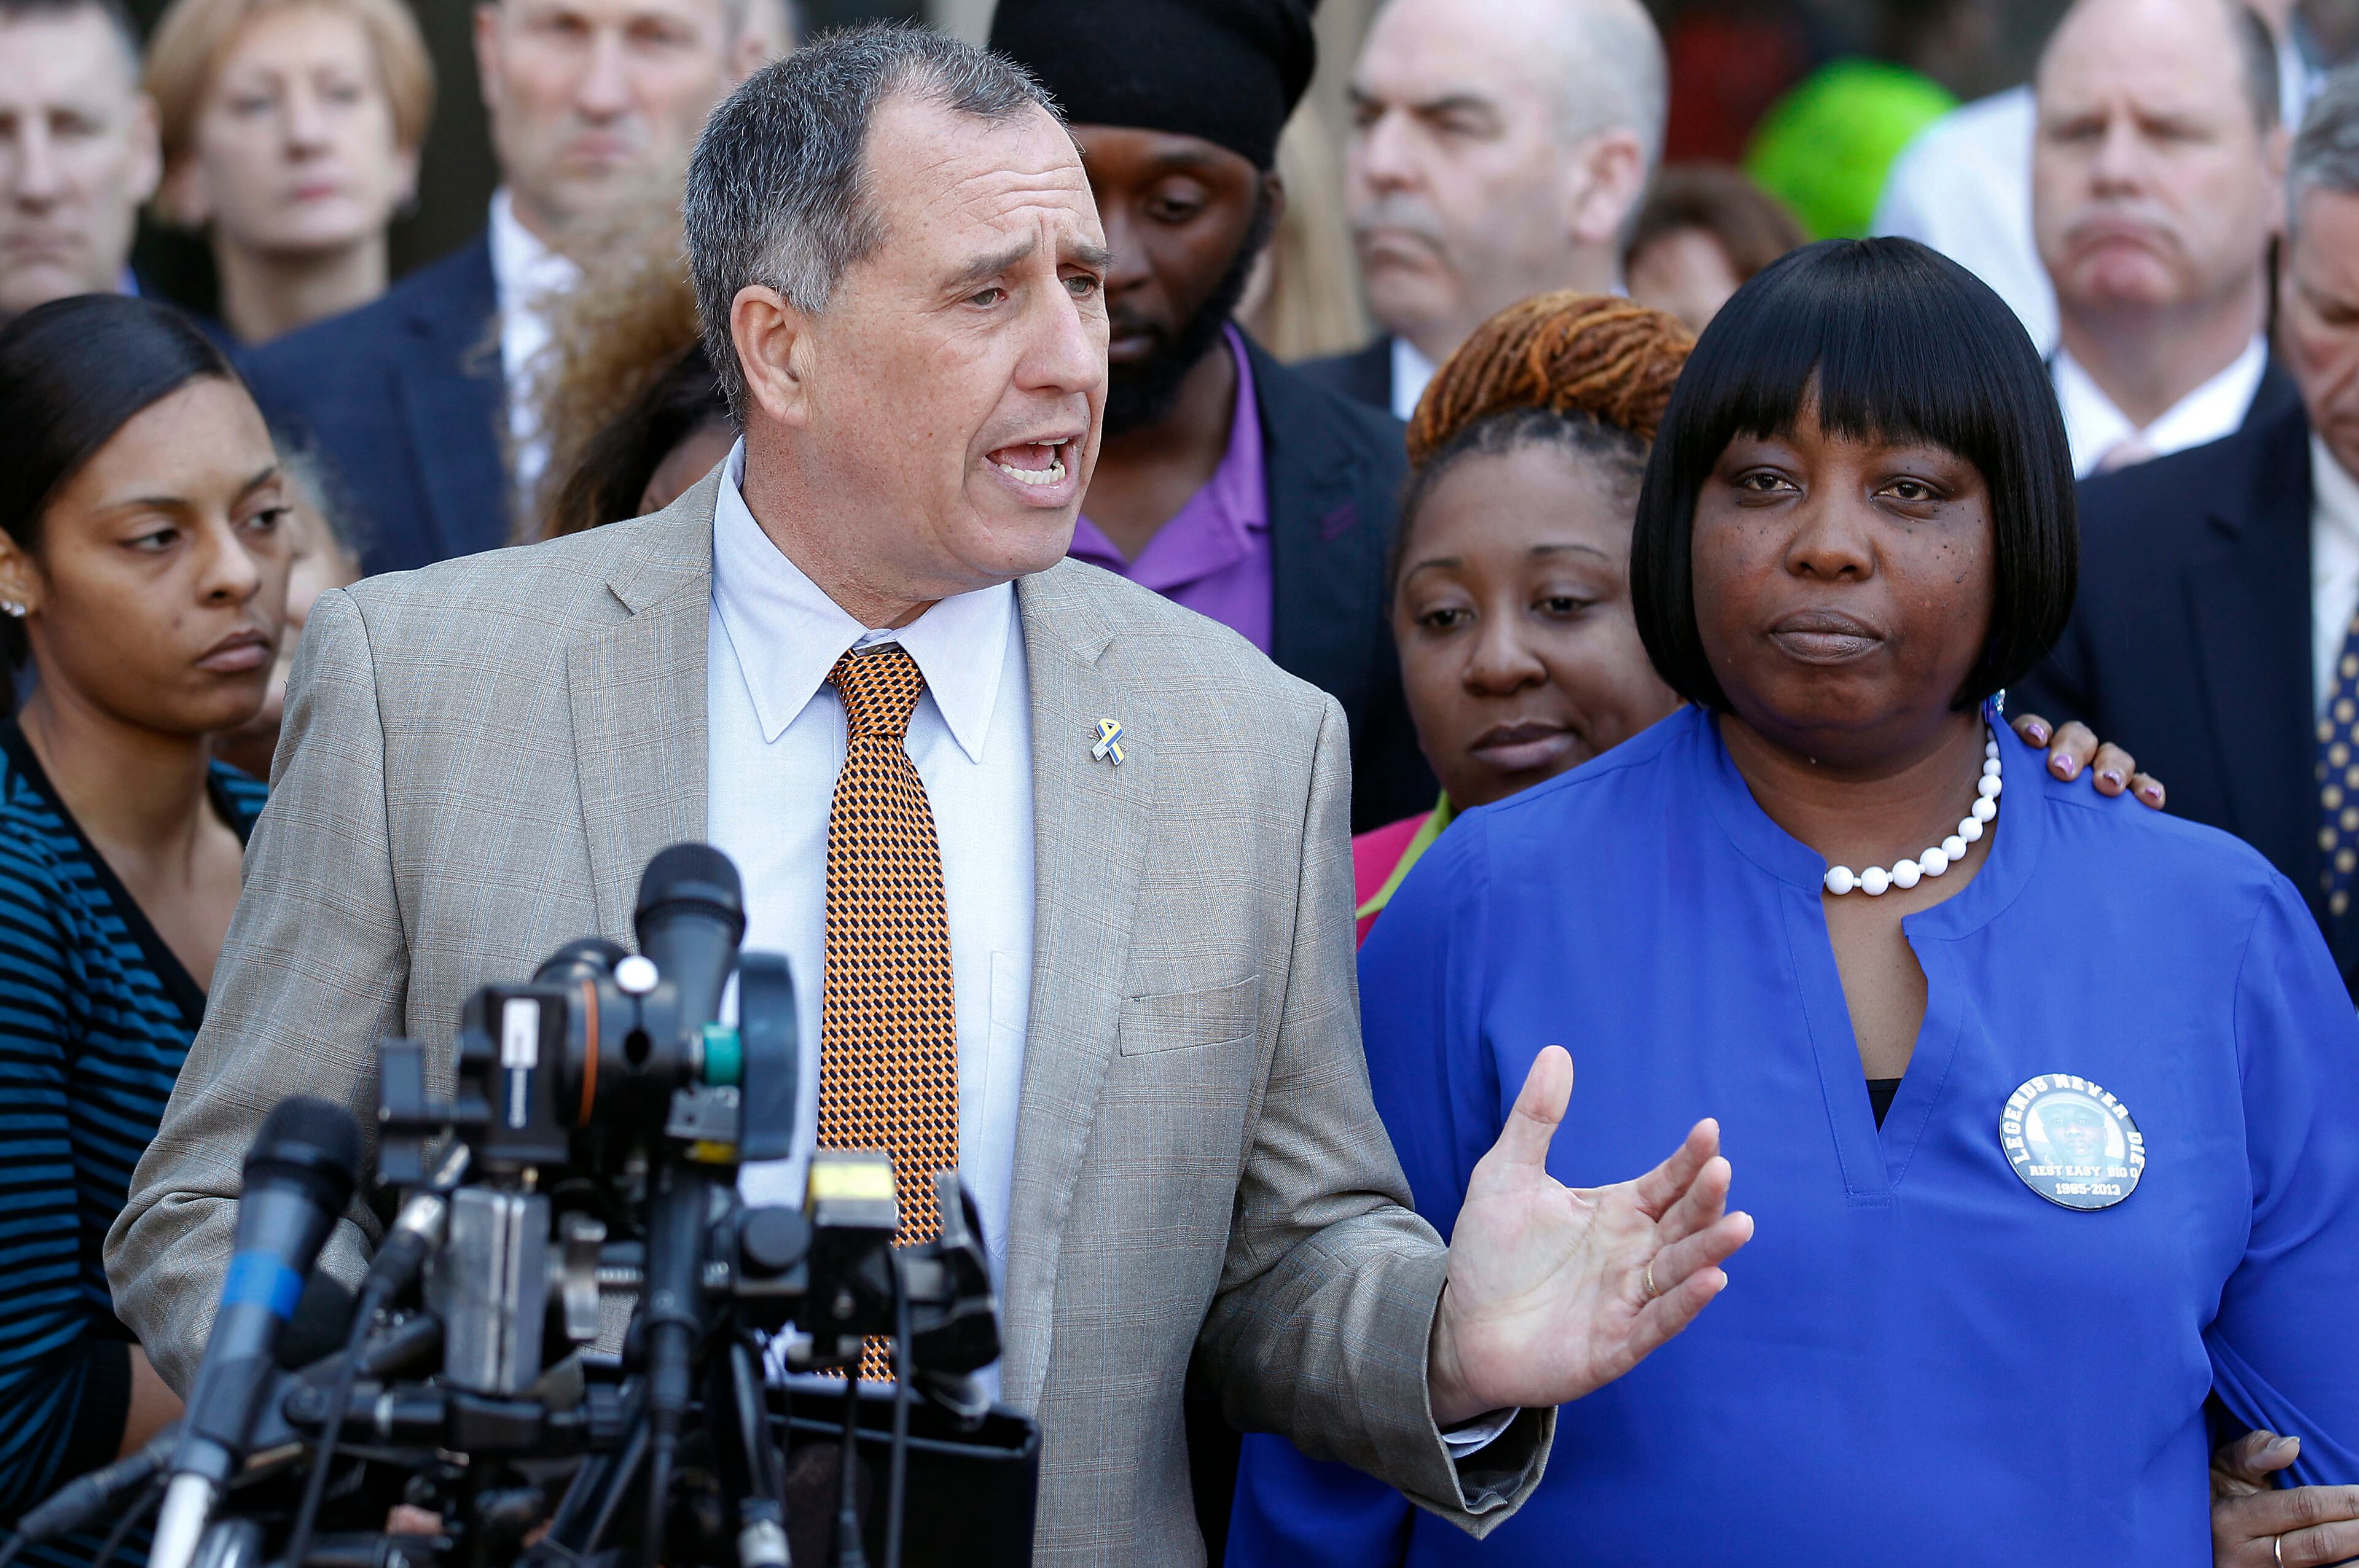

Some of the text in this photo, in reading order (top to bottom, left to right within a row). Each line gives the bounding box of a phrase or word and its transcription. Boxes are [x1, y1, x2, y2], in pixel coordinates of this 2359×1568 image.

[2003, 1074, 2145, 1168] LEGENDS NEVER DIE
[2029, 1165, 2062, 1176] REST
[2067, 1166, 2101, 1177] EASY
[2107, 1167, 2128, 1178] BIG
